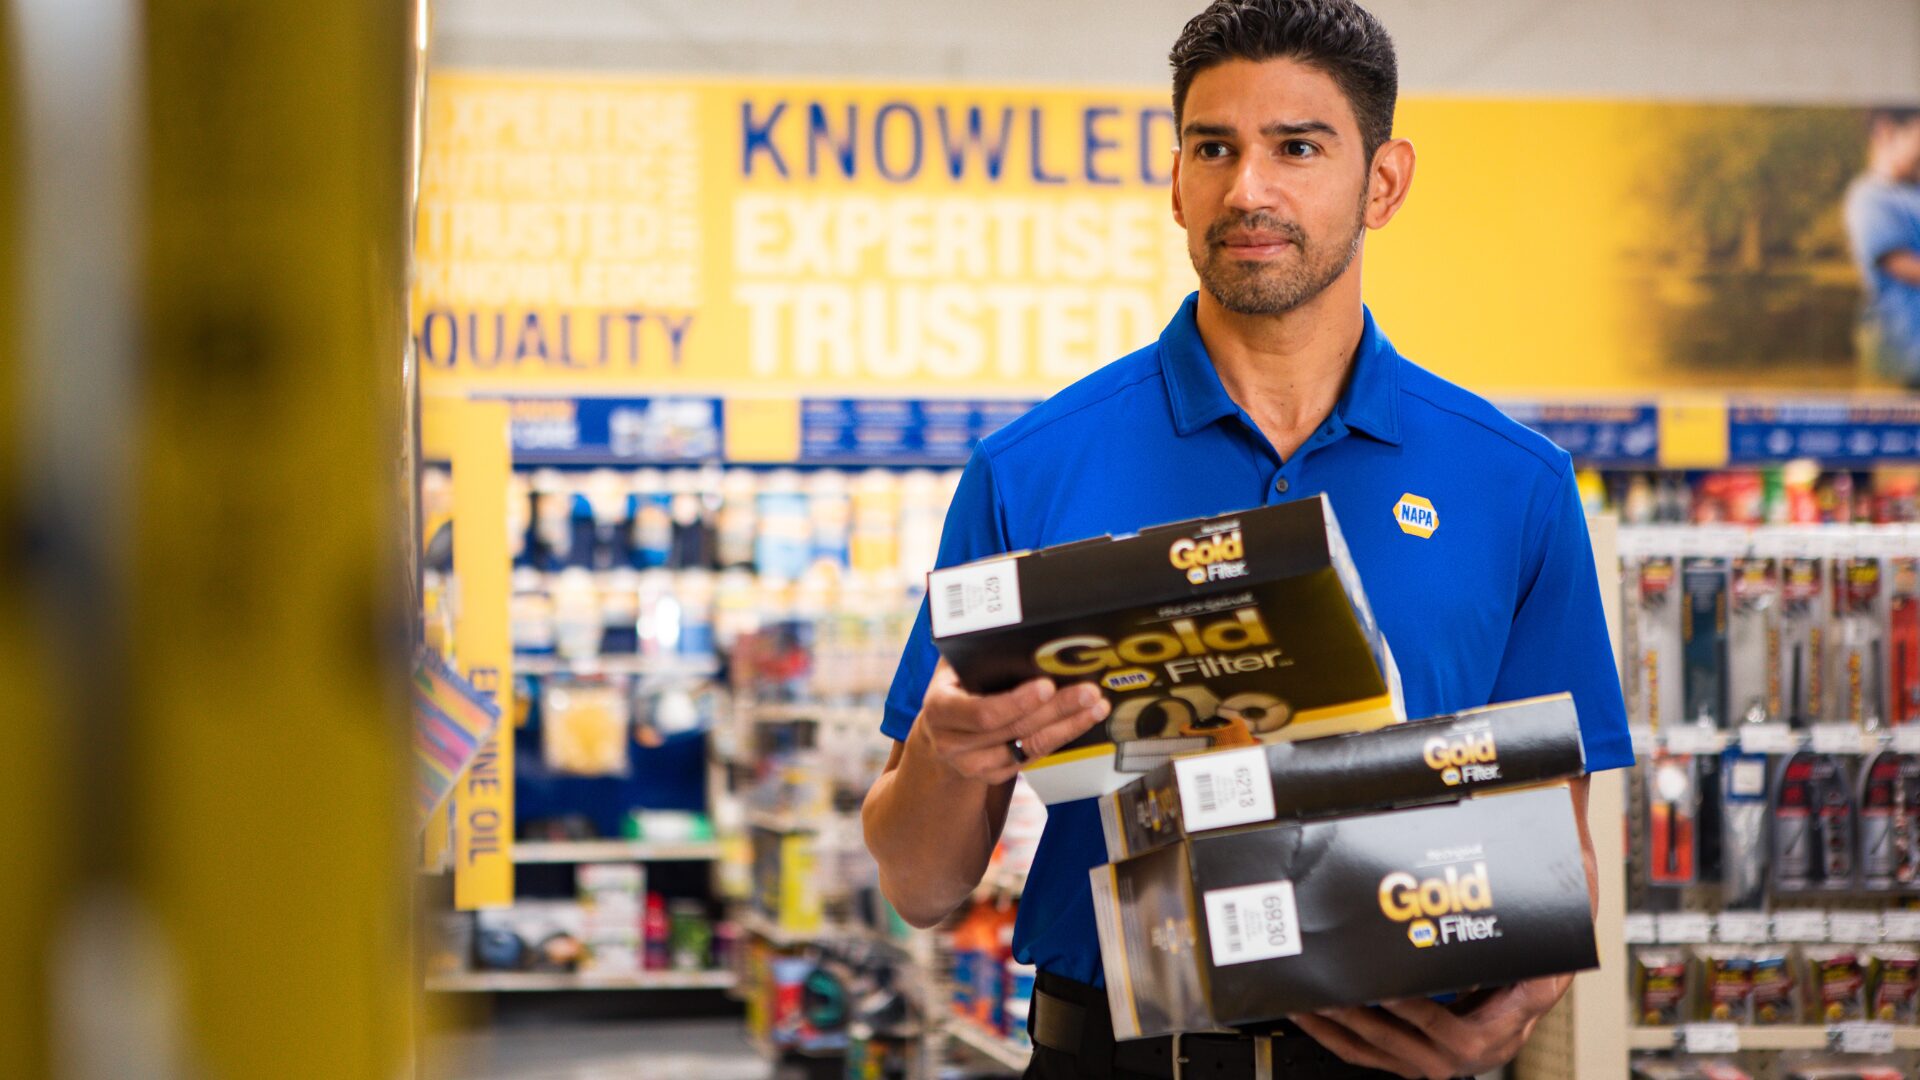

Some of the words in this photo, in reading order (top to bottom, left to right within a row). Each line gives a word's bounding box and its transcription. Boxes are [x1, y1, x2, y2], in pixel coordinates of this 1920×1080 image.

[420, 200, 661, 256] TRUSTED
[733, 191, 1157, 279] EXPERTISE
[422, 312, 694, 368] QUALITY
[732, 280, 1154, 379] TRUSTED
[1401, 504, 1433, 528] NAPA
[1169, 529, 1244, 570] Gold
[1206, 562, 1246, 582] Filter
[984, 575, 1002, 614] 6213
[1034, 607, 1272, 677] Gold
[1108, 673, 1147, 688] NAPA
[1164, 650, 1282, 684] Filter
[1423, 730, 1498, 771] Gold
[1236, 767, 1255, 809] 6213
[469, 808, 499, 867] OIL
[1378, 860, 1494, 923] Gold
[1262, 895, 1287, 947] 6930
[1438, 914, 1498, 945] Filter
